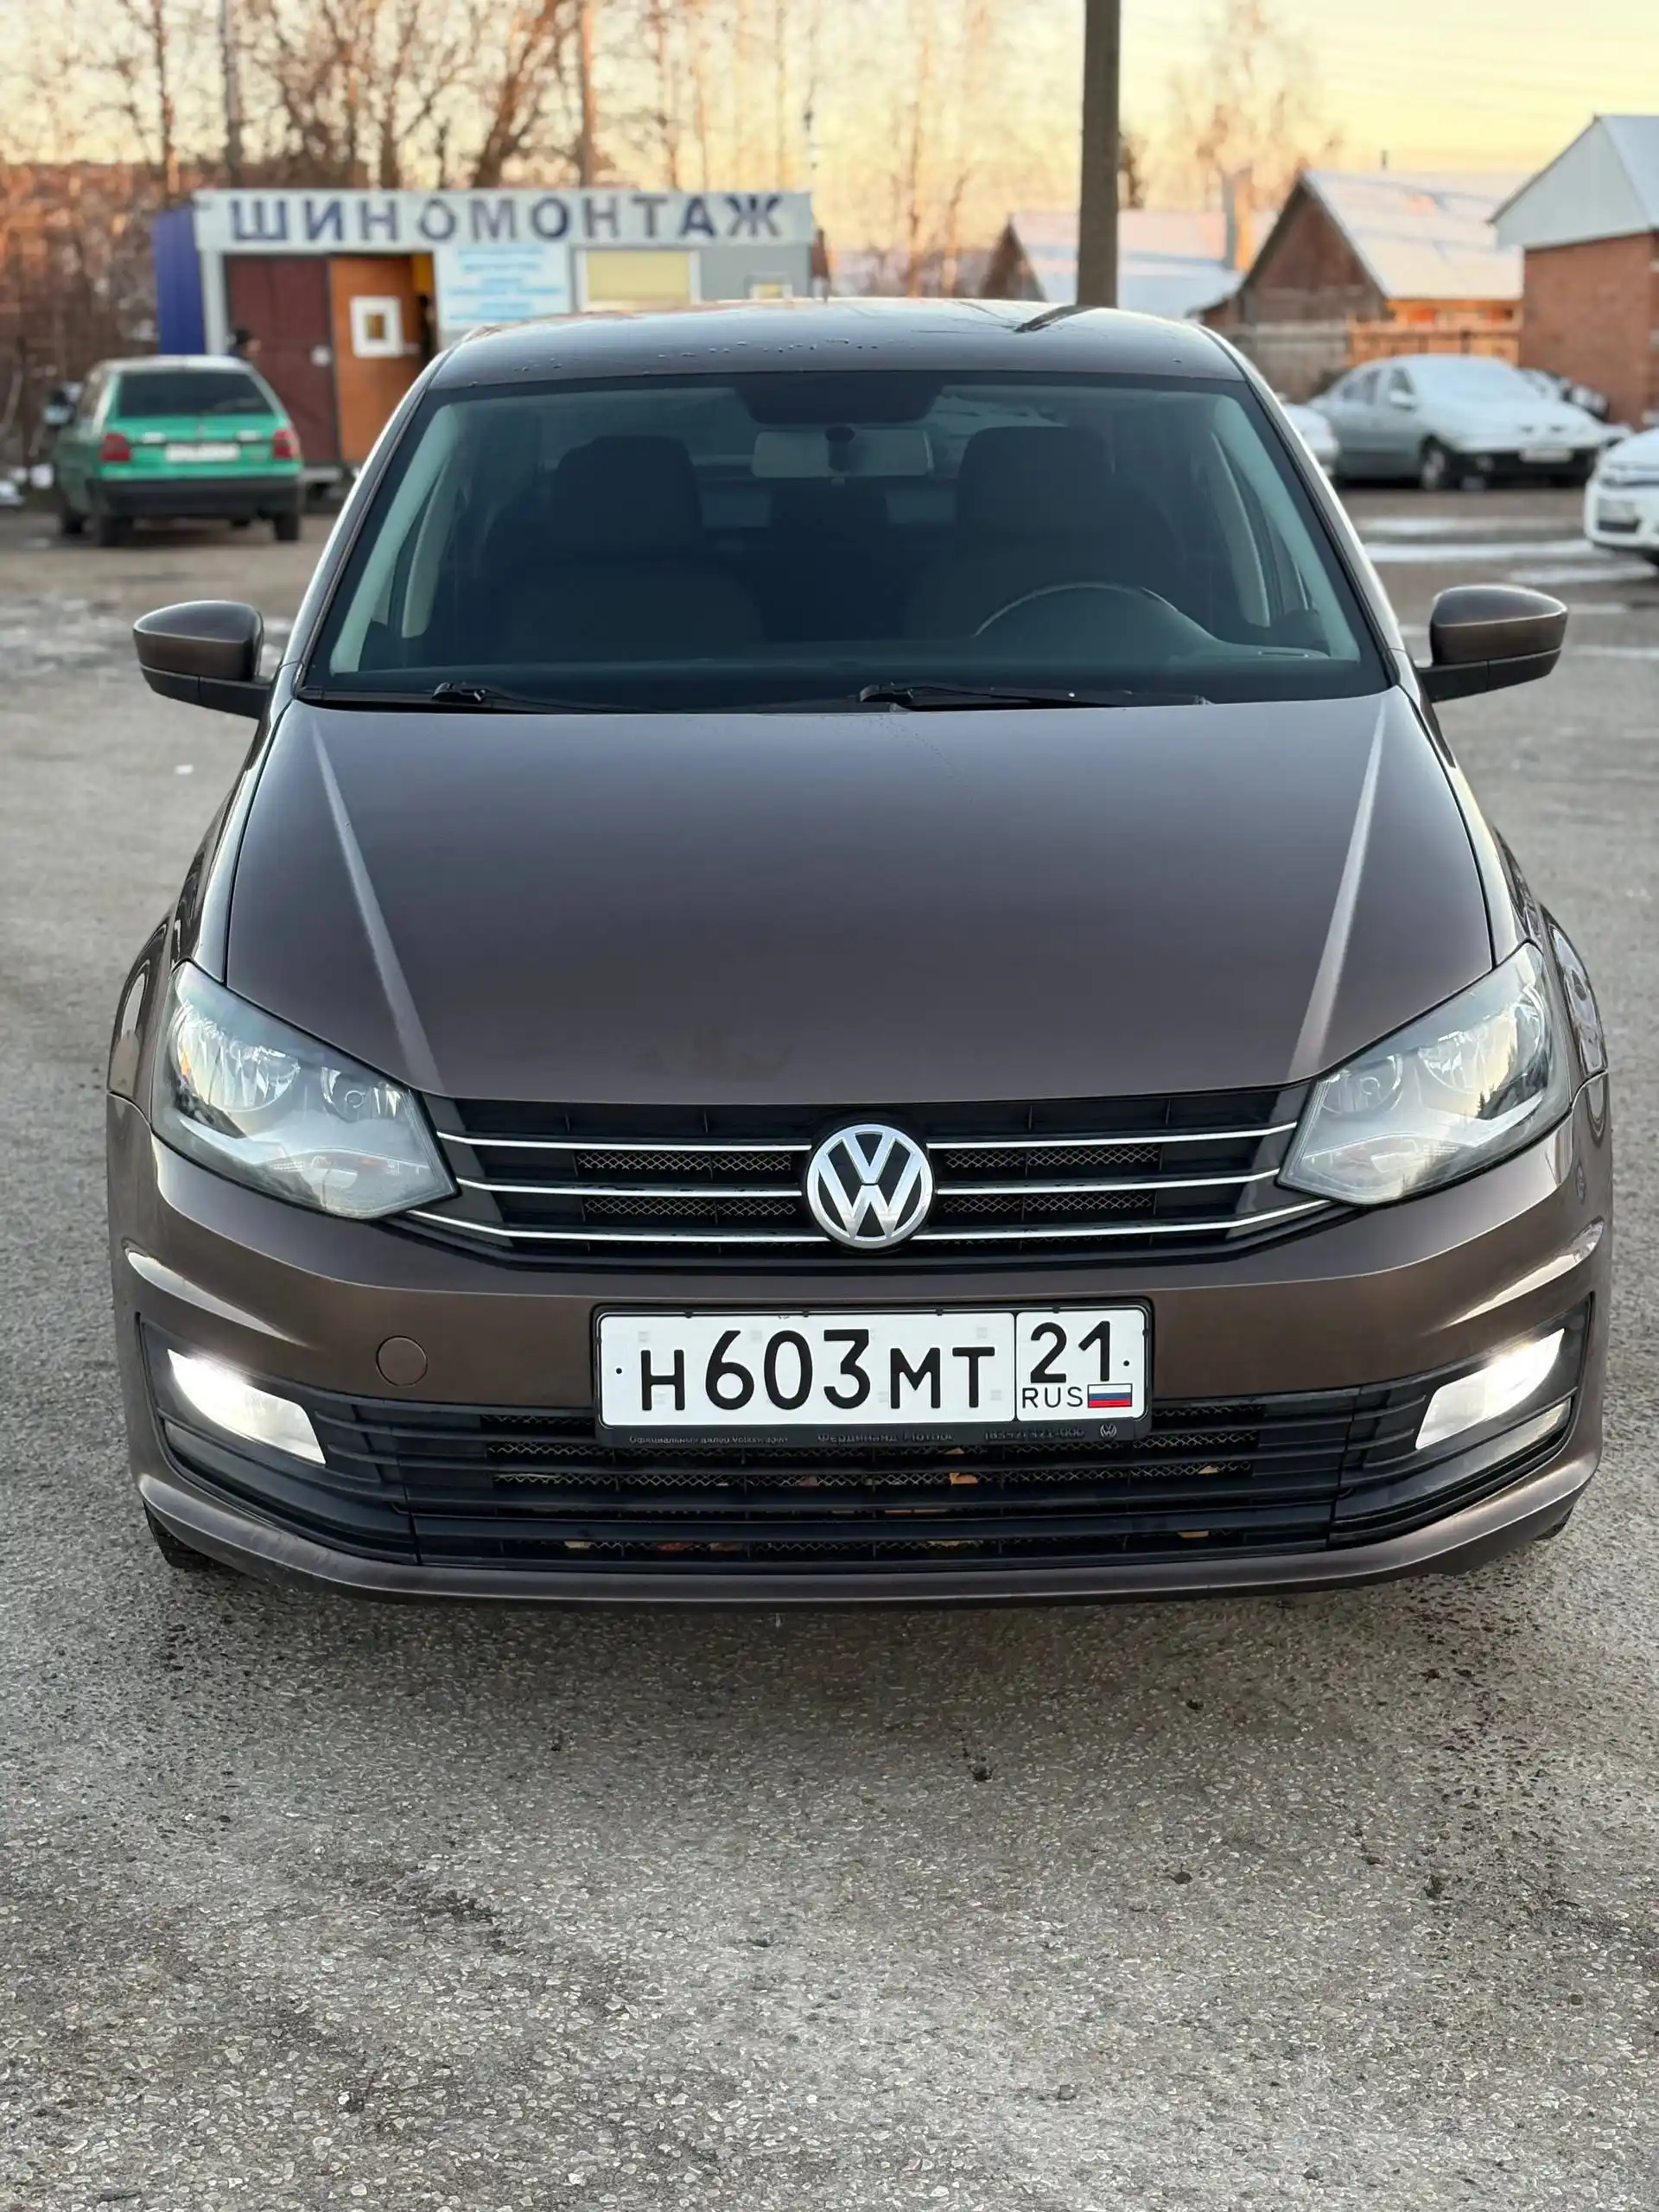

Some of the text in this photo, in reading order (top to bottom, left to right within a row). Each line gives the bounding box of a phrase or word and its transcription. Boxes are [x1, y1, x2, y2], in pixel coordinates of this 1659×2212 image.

[231, 196, 782, 242] ШИНОМОНТАЖ
[807, 1124, 933, 1249] VW
[1030, 1320, 1111, 1383] 21
[1021, 1386, 1084, 1409] RUS
